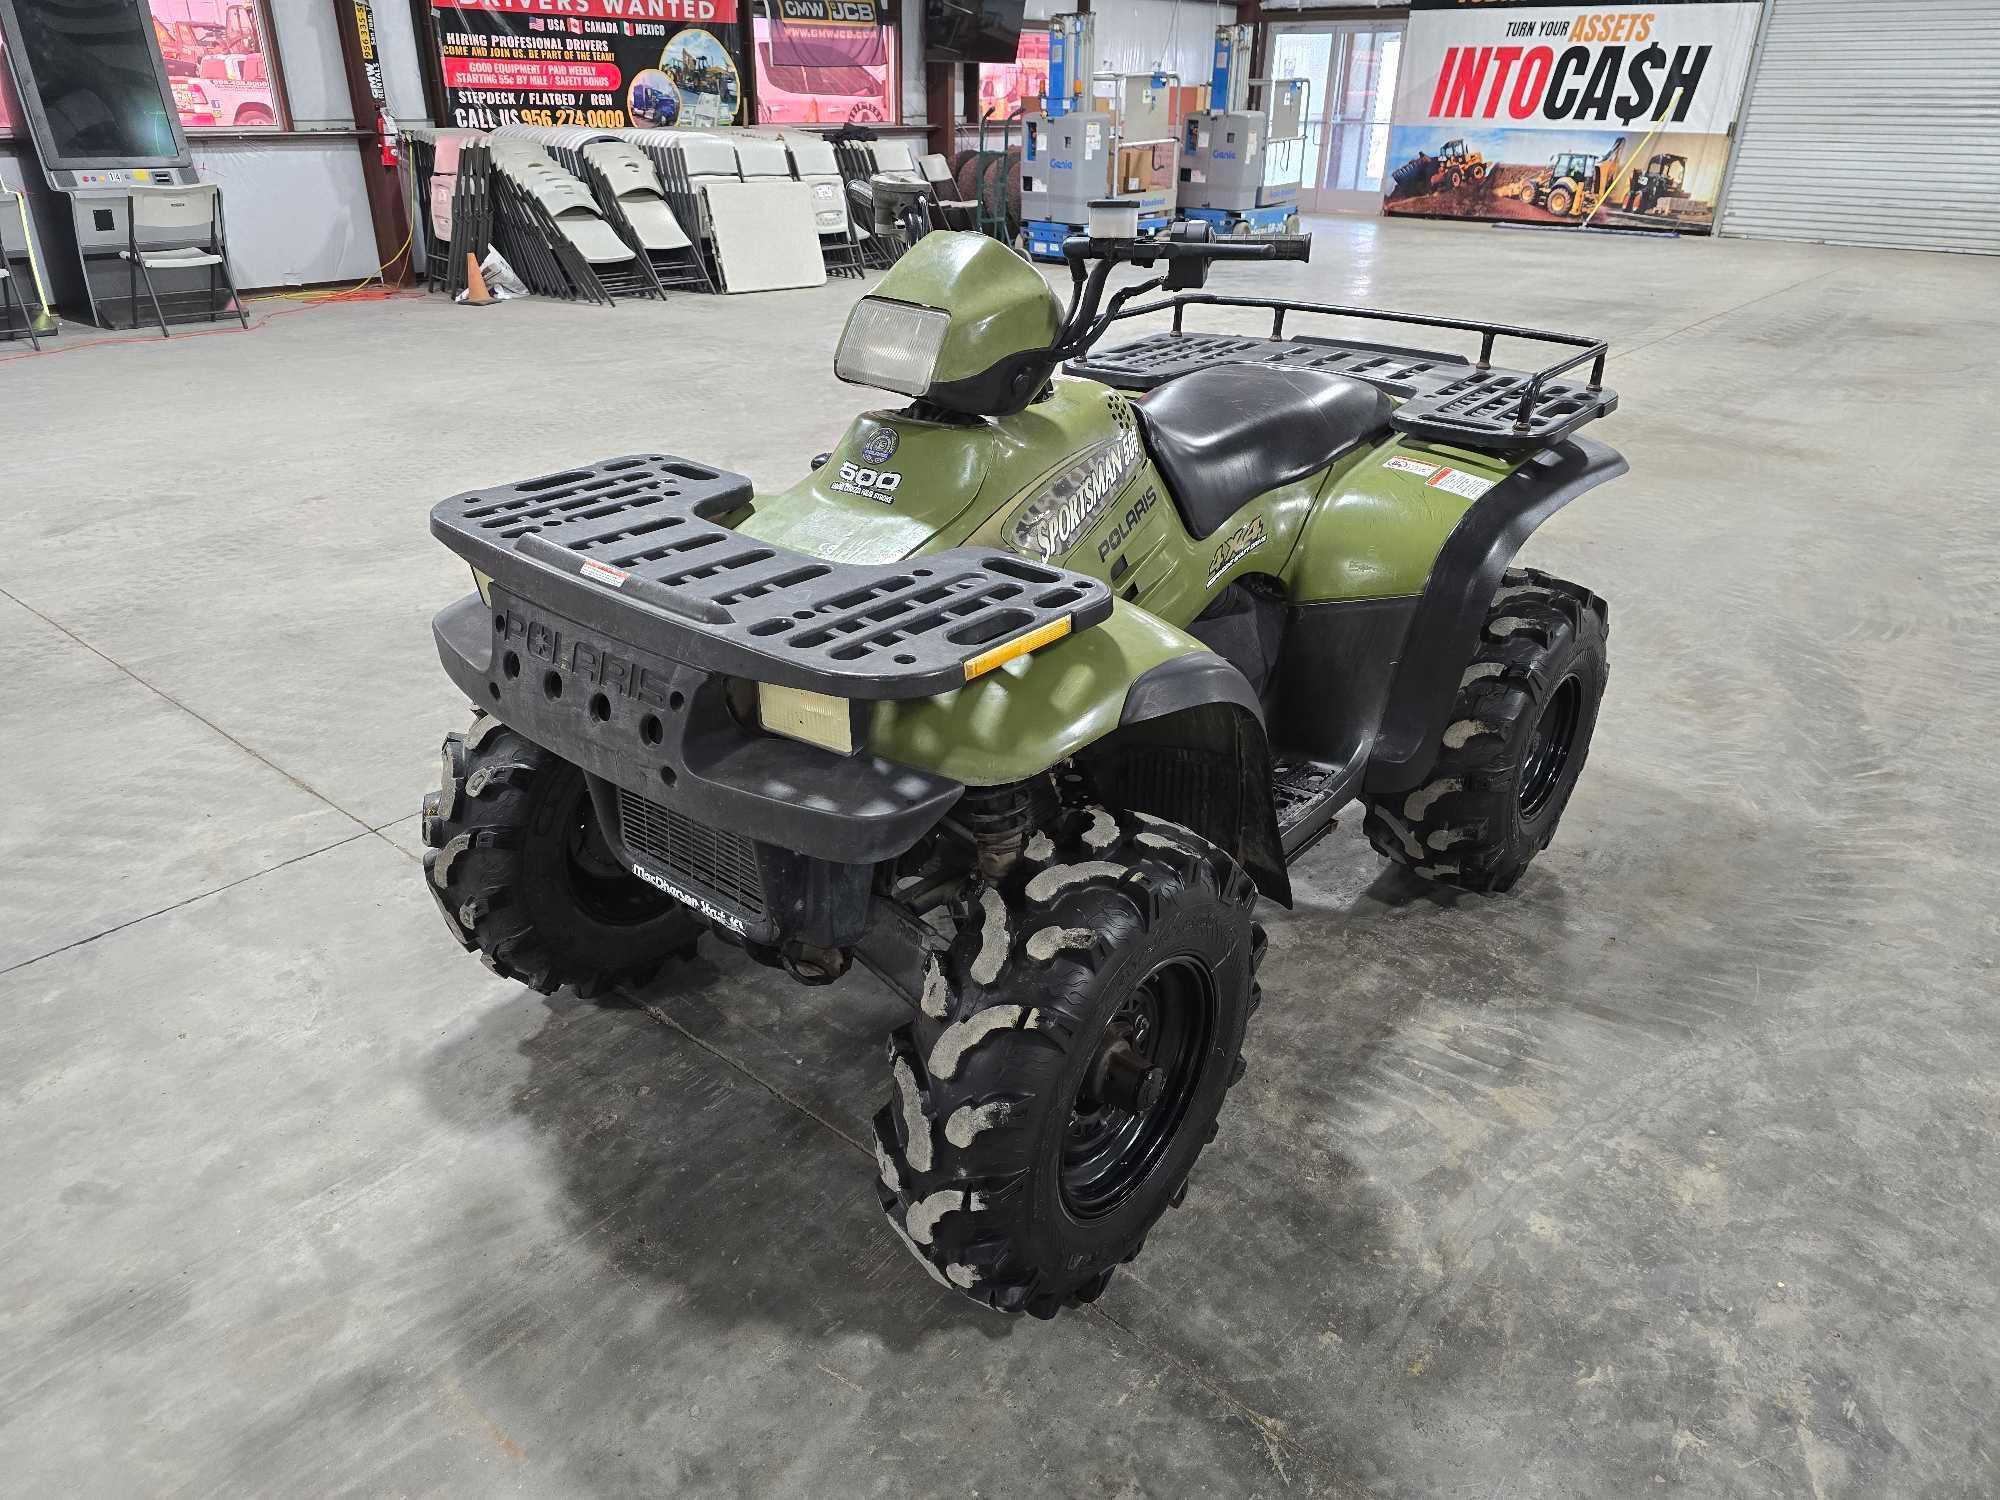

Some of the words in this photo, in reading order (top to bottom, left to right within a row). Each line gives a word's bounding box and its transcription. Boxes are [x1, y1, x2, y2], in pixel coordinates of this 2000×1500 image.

[603, 0, 715, 19] WANTED
[785, 1, 824, 17] GMW
[832, 2, 874, 20] JCB
[547, 19, 566, 31] USA
[584, 20, 619, 34] CANADA
[635, 23, 666, 36] MEXICO
[1506, 21, 1536, 37] TURN
[1539, 20, 1570, 37] YOUR
[1568, 13, 1655, 43] ASSETS
[362, 39, 372, 58] 956
[446, 33, 487, 47] HIRING
[491, 35, 564, 50] PROFESIONAL
[565, 39, 609, 52] DRIVERS
[443, 45, 469, 56] COME
[471, 46, 488, 57] AND
[490, 47, 510, 58] JOIN
[513, 48, 526, 59] US.
[529, 48, 540, 59] BE
[541, 49, 561, 60] PART
[564, 50, 575, 60] OF
[577, 51, 592, 61] THE
[593, 52, 615, 62] TEAM!
[469, 62, 492, 73] GOOD
[494, 63, 540, 74] EQUIPMENT
[548, 64, 567, 75] PAID
[568, 65, 597, 76] WEEKLY
[365, 62, 379, 99] GMW
[372, 62, 385, 99] RENTALS
[456, 73, 499, 84] STARTING
[516, 74, 527, 84] BY
[529, 75, 548, 86] MILE
[555, 76, 581, 86] SAFETY
[583, 77, 609, 87] BONUS
[458, 91, 516, 105] STEPDECK
[529, 93, 575, 106] FLATBED
[590, 94, 613, 106] RGN
[454, 109, 497, 129] CALL
[499, 109, 519, 127] US
[520, 110, 625, 128] 956.274.0000
[839, 461, 902, 491] 500
[1037, 444, 1123, 564] SPORTSMAN
[1098, 485, 1158, 563] POLARIS
[504, 609, 670, 711] POLARIS
